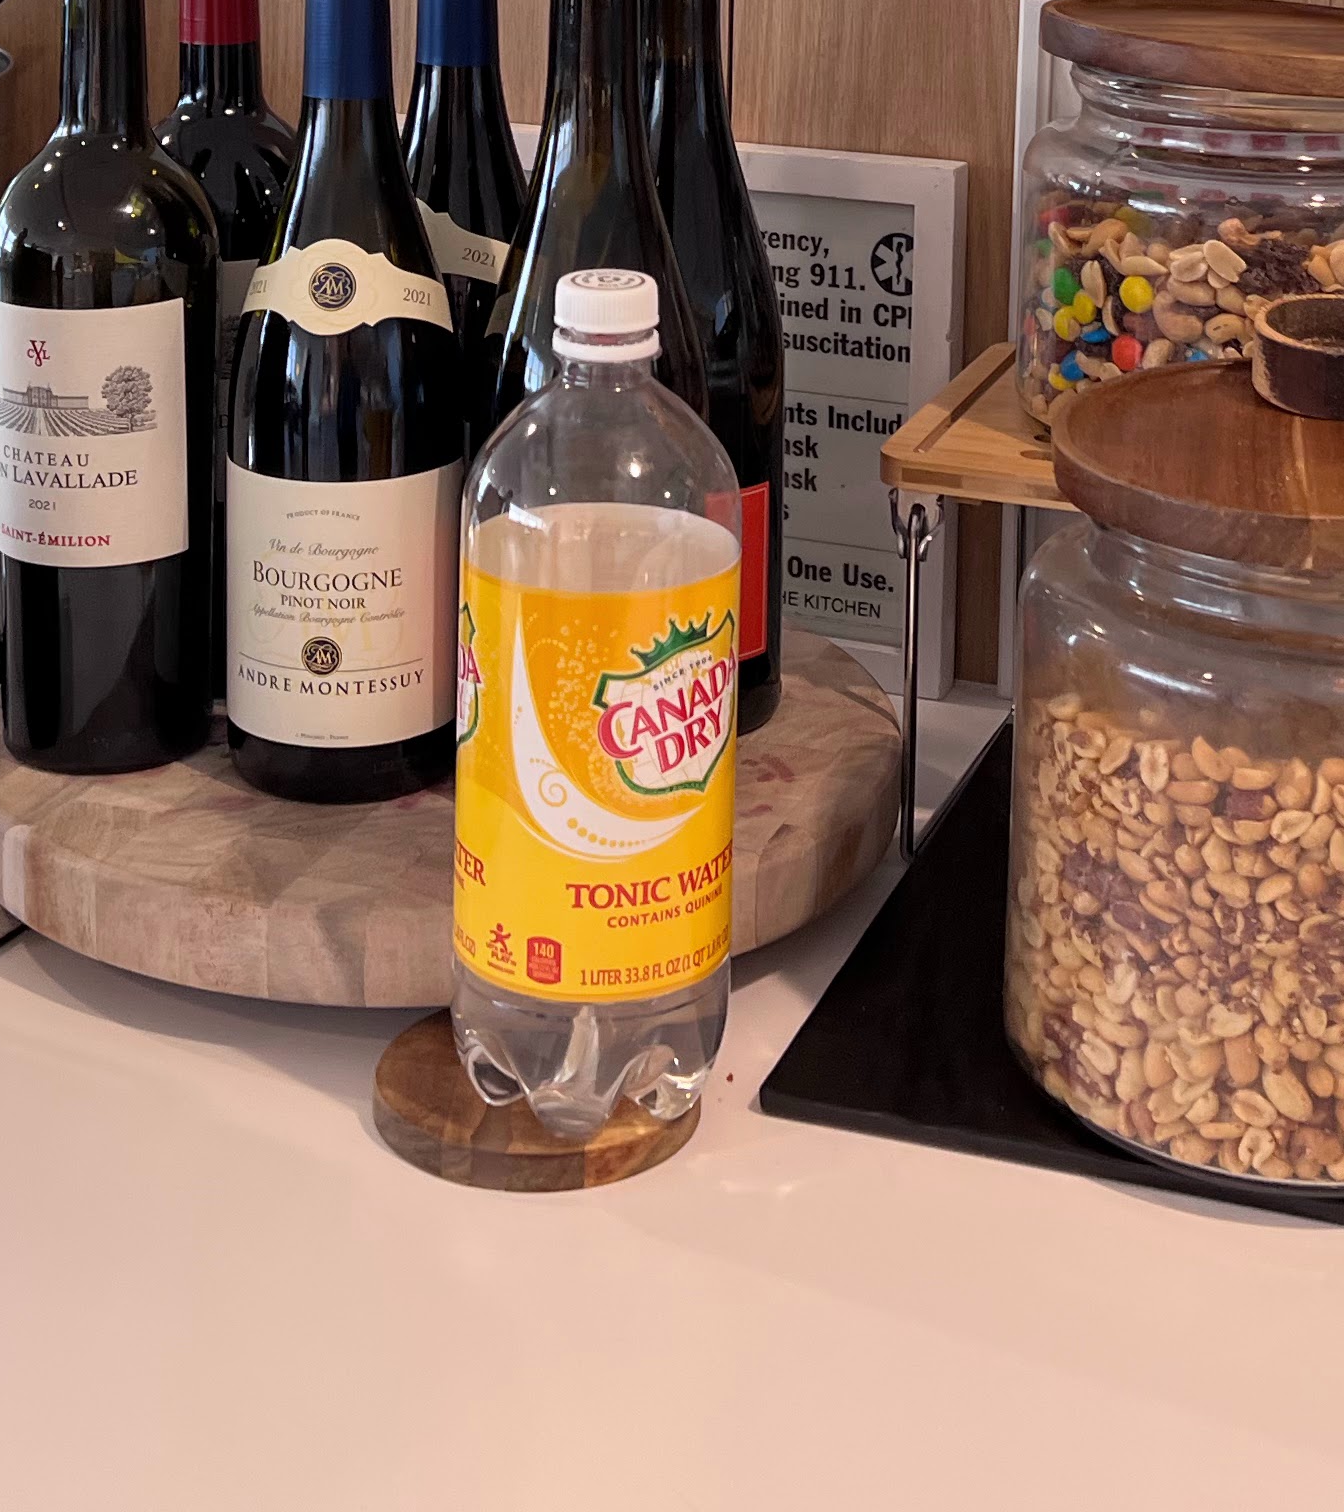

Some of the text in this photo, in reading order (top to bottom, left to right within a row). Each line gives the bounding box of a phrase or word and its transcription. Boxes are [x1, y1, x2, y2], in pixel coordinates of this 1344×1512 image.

[461, 247, 496, 268] 2021
[810, 263, 866, 291] 911.
[403, 287, 431, 306] 2021
[779, 293, 912, 330] ined in CP
[783, 332, 911, 363] suscitation
[3, 445, 89, 468] CHATEAU
[13, 464, 138, 489] LAVALLADE
[28, 498, 56, 511] 2021
[286, 509, 319, 520] PRODUCT
[331, 510, 361, 521] FRANCE
[1, 523, 111, 547] SAINT-ÉMILION
[268, 538, 379, 561] Vin de Bourgogne
[253, 560, 403, 593] BOURGOGNE
[787, 555, 894, 593] One Use.
[281, 594, 366, 610] PINOT NOIR
[804, 593, 882, 619] KITCHEN
[299, 611, 356, 628] Bourgogne
[238, 663, 425, 696] ANDRE MONTESSUY
[653, 654, 714, 690] SINCE 1904
[598, 645, 736, 759] CANADA
[655, 699, 723, 774] DRY
[566, 876, 671, 910] TONIC
[607, 906, 681, 928] CONTAINS
[533, 942, 555, 958] 140
[580, 969, 587, 985] 1
[591, 969, 622, 986] LITER
[625, 965, 650, 985] 33.8
[652, 963, 664, 980] FL
[666, 957, 681, 976] OZ
